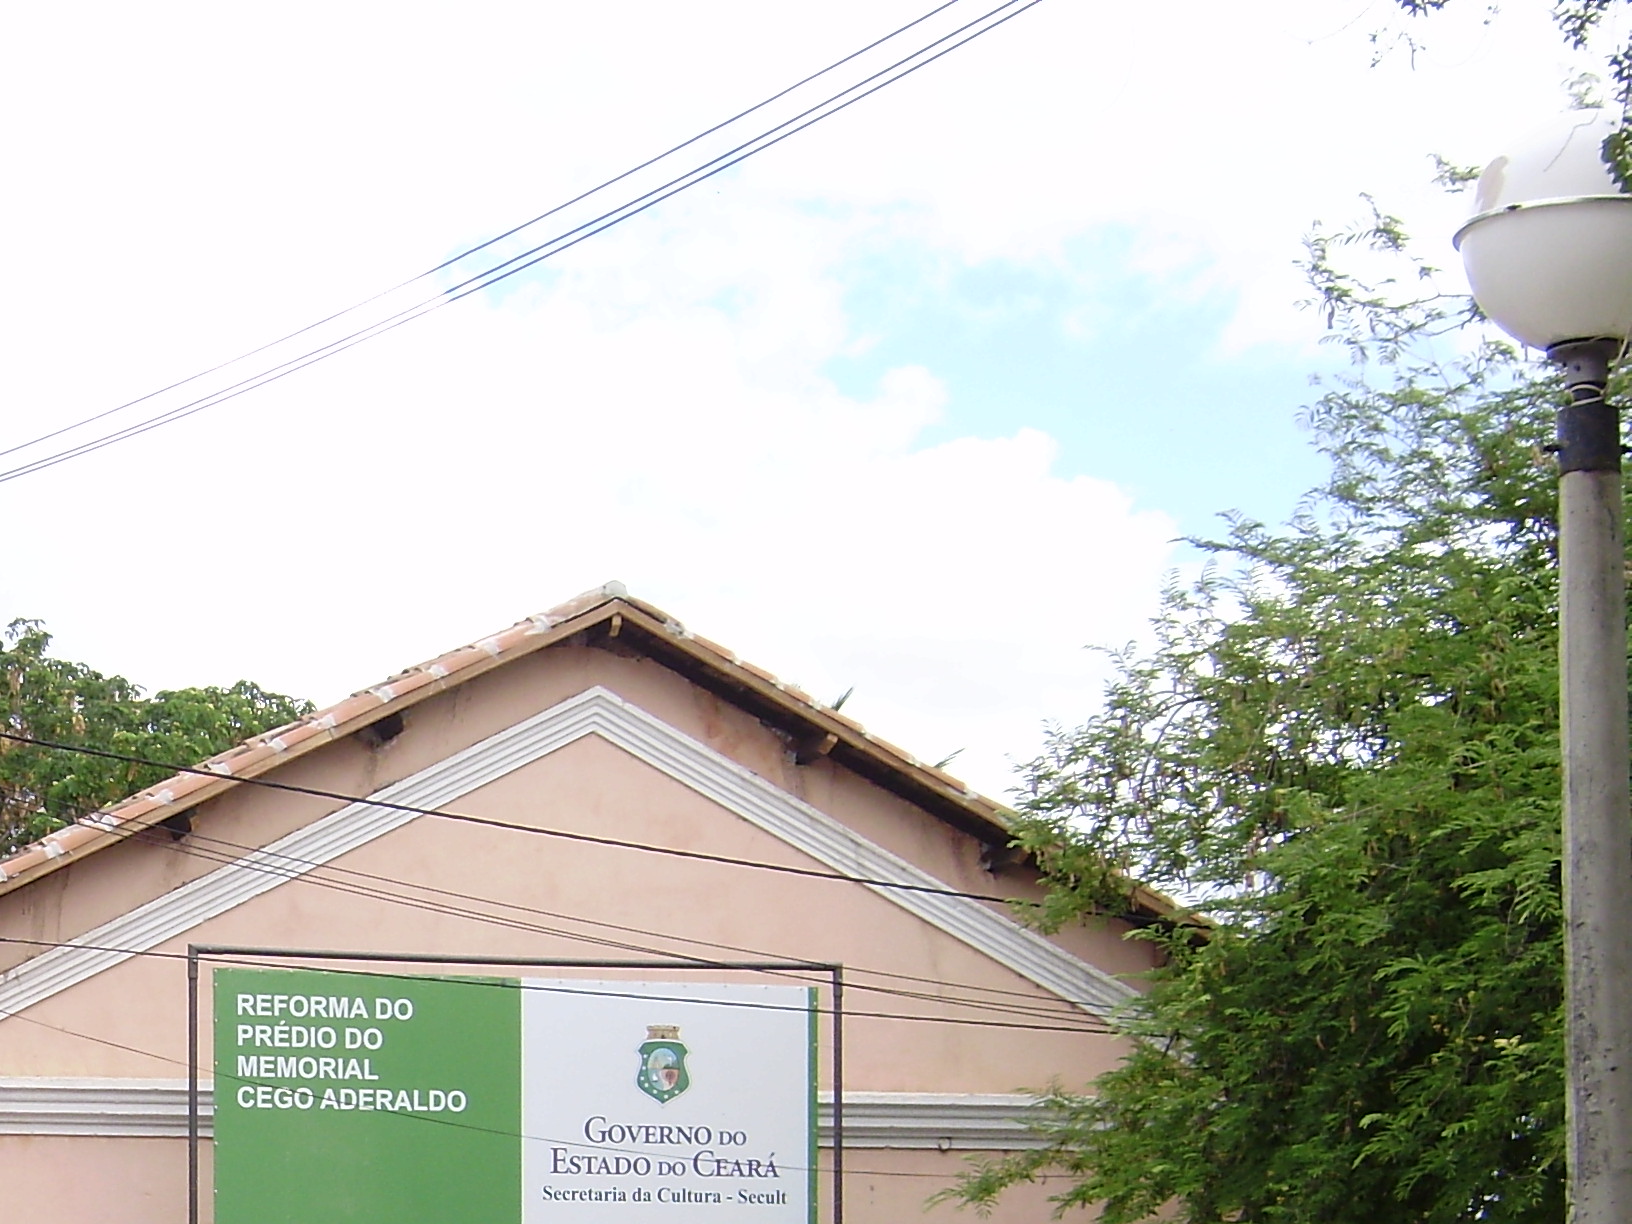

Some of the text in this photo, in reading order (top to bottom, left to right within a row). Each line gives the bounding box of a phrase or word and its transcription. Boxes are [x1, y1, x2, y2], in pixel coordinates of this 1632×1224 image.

[237, 994, 413, 1020] REFORMA DO
[237, 1020, 383, 1050] PRÉDIO DO
[237, 1055, 379, 1080] MEMORIAL
[237, 1086, 467, 1112] CEGO ADERALDO
[542, 1185, 626, 1202] Secretaria
[632, 1187, 651, 1202] da
[657, 1188, 721, 1203] Cultura
[738, 1189, 787, 1205] Secult
